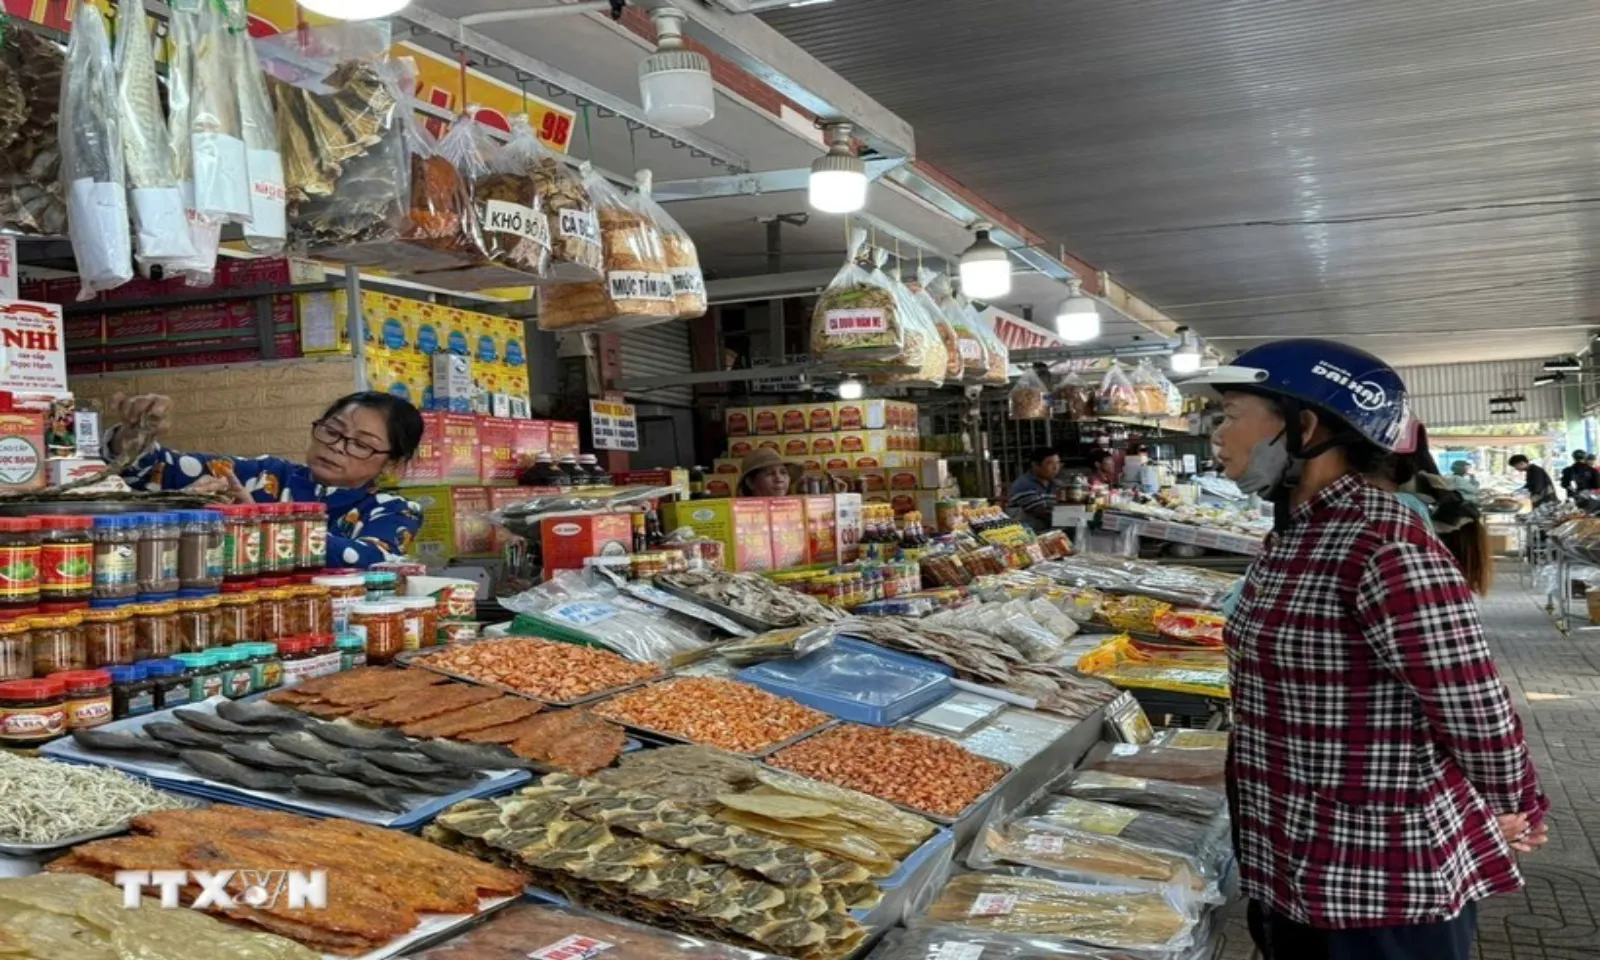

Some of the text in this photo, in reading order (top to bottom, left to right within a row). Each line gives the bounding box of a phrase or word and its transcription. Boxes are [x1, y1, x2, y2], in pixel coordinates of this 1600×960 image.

[491, 210, 522, 231] KHÔ
[562, 212, 578, 234] CÁ
[611, 275, 637, 297] MỰC
